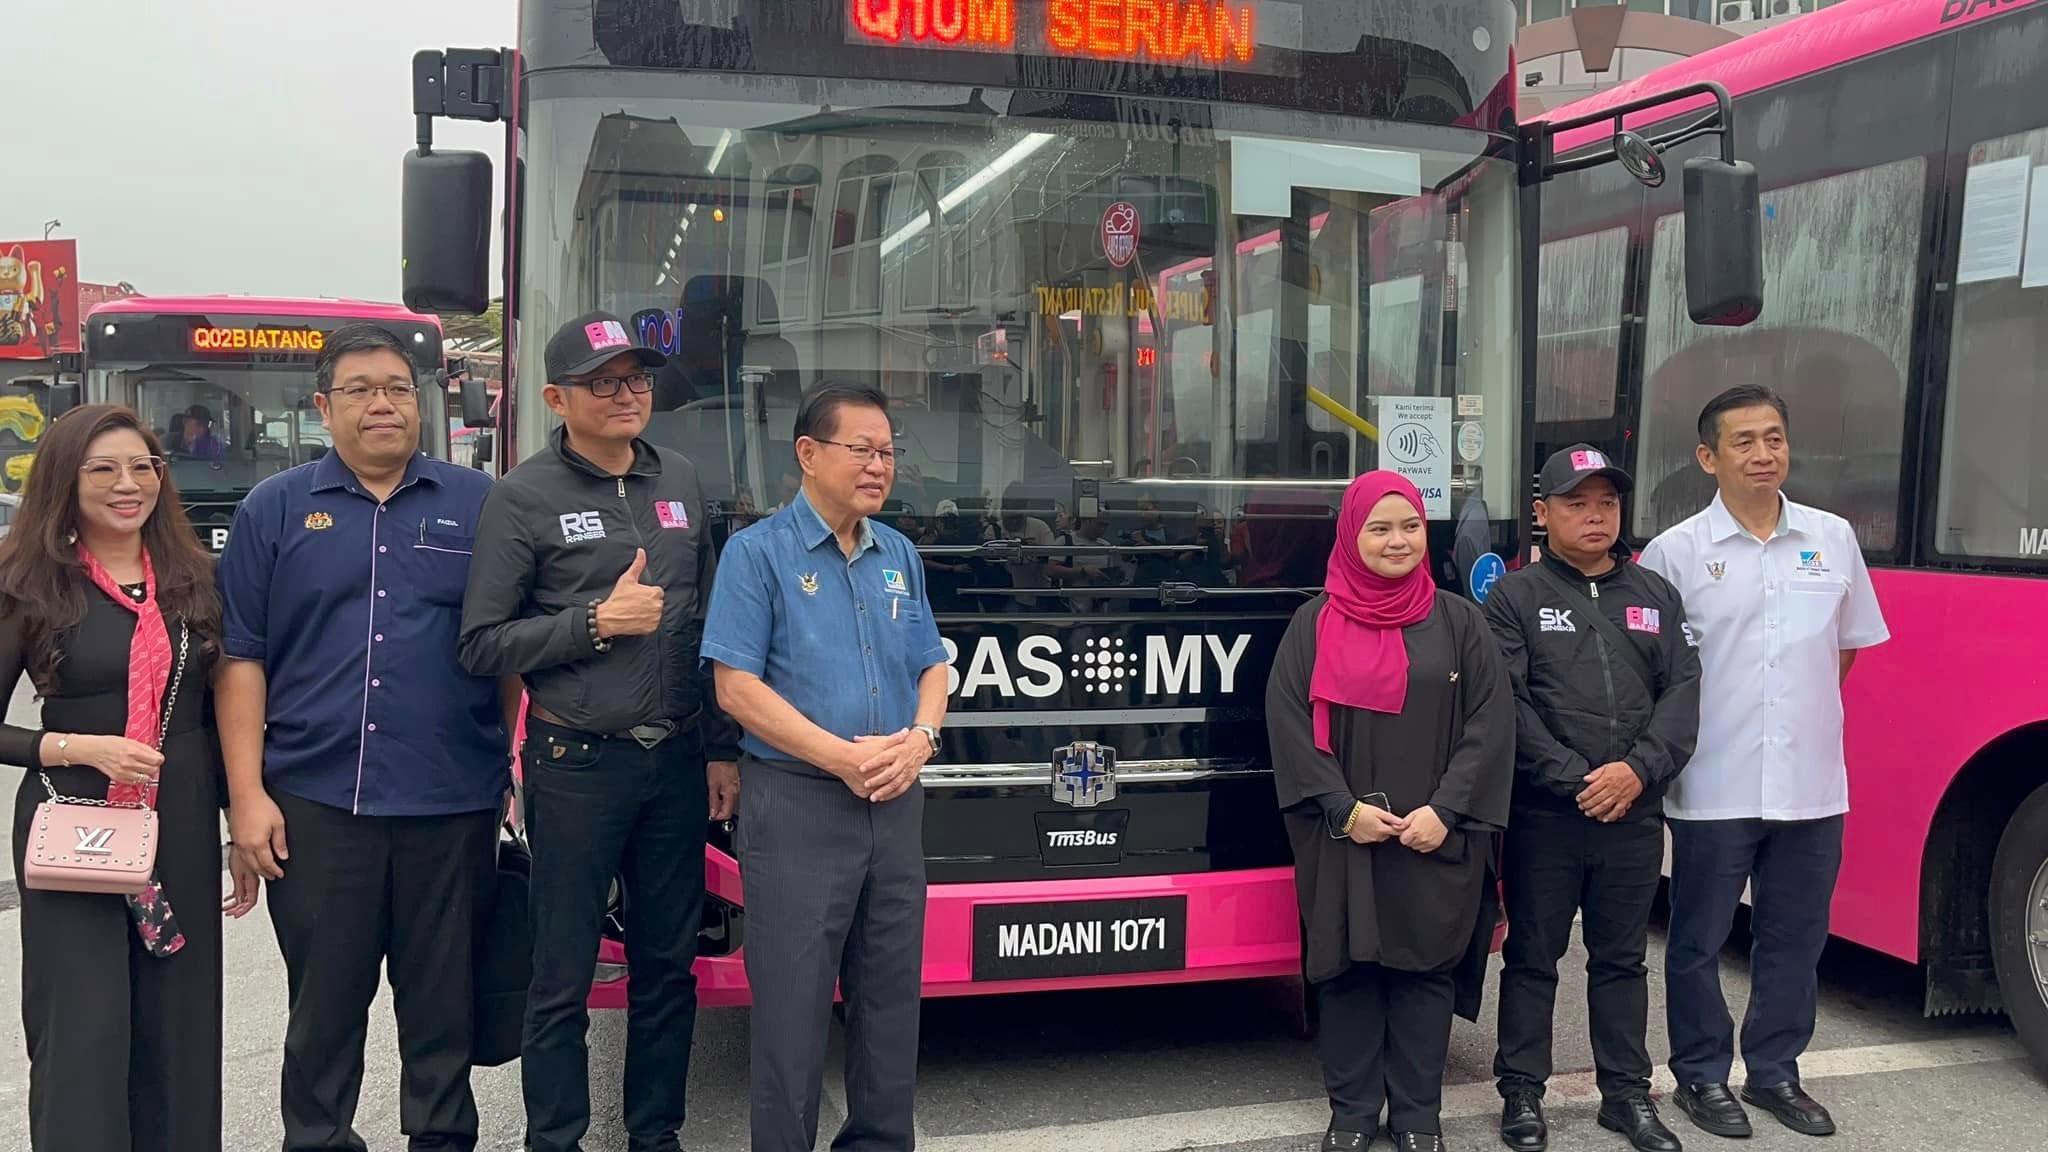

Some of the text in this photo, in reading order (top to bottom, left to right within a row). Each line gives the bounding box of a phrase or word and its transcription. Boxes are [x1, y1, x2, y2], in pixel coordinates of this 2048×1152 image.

[856, 0, 1250, 61] Q10M SERIAN
[1398, 467, 1432, 475] PAYWAVE
[560, 511, 604, 536] RG
[1539, 608, 1573, 625] SK
[1145, 634, 1252, 695] MY
[1046, 830, 1118, 847] TmsBus
[999, 917, 1166, 958] MADANI 1071
